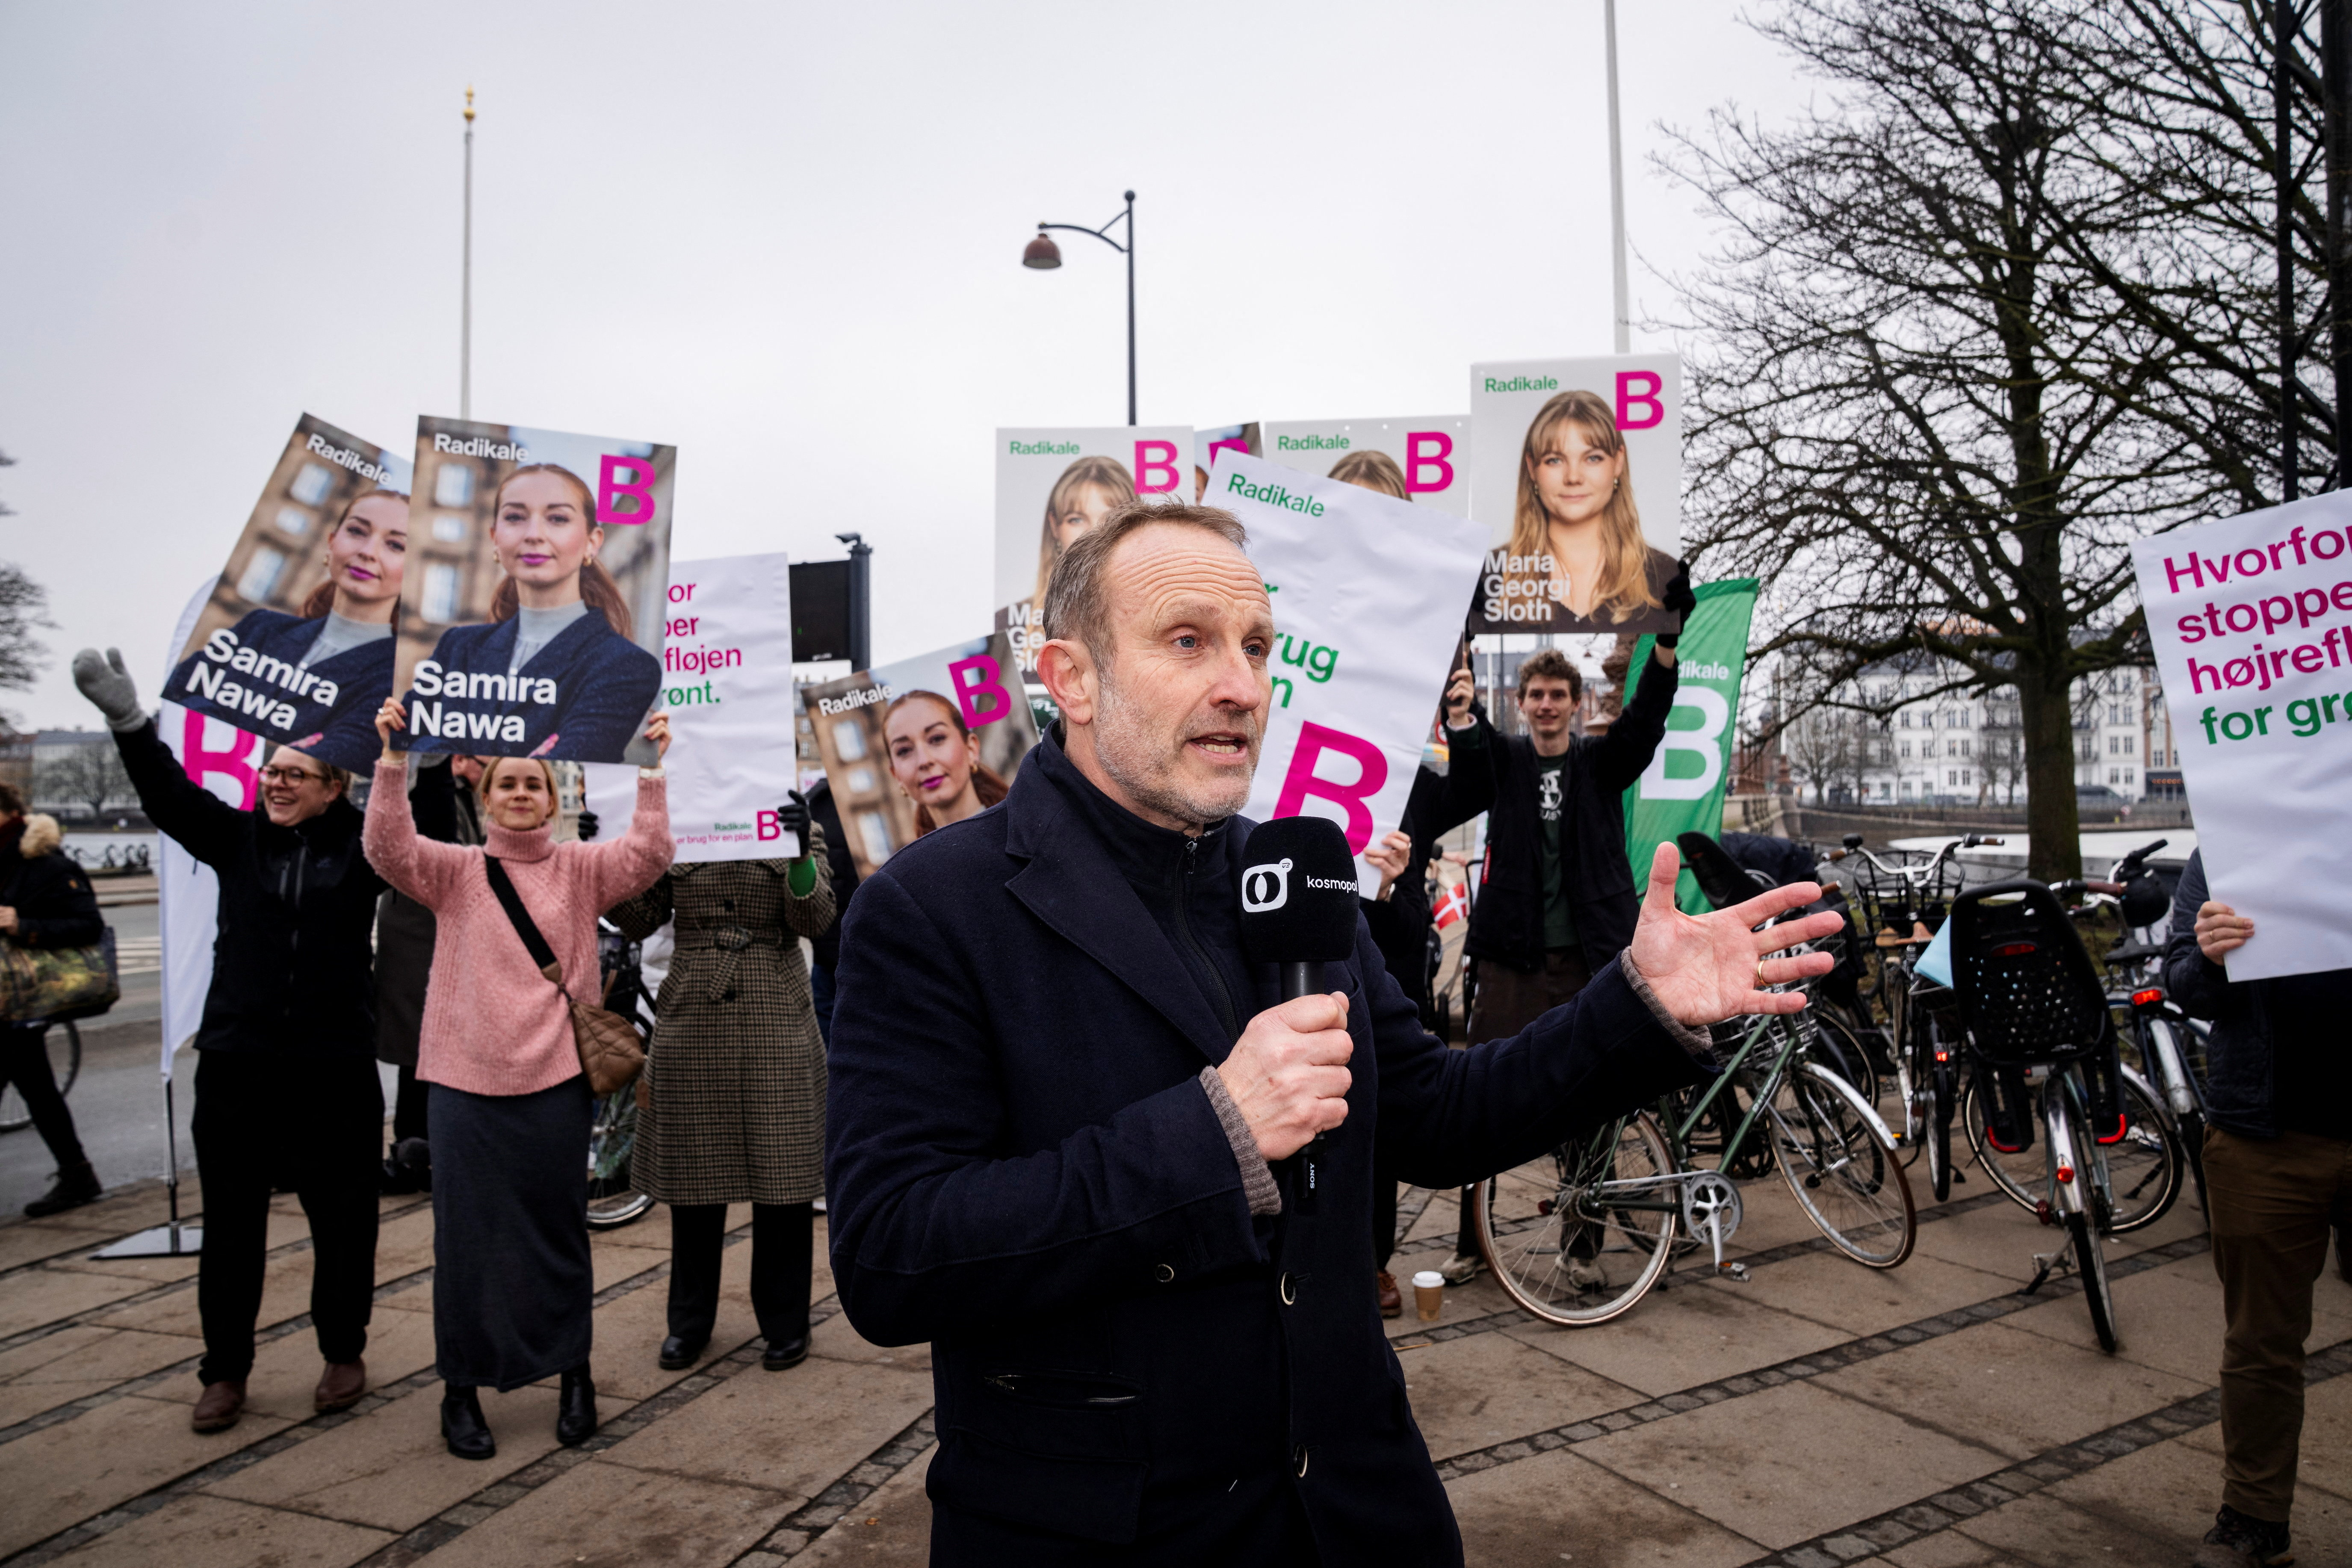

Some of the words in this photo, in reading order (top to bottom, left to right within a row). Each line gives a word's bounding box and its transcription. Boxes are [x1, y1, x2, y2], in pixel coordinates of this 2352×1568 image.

[1485, 375, 1558, 392] Radikale
[1616, 370, 1665, 431] B
[305, 434, 392, 486] Radikale
[434, 433, 529, 462] Radikale
[1010, 440, 1080, 455] Radikale
[1278, 434, 1350, 450] Radikale
[1405, 431, 1454, 494] B
[1134, 440, 1180, 495] B
[595, 454, 656, 526] B
[1227, 473, 1324, 517] Radikale
[1484, 550, 1555, 573] Maria
[1483, 574, 1571, 601] Georgi
[1484, 599, 1551, 621] Sloth
[2178, 582, 2352, 644] stoppe
[204, 628, 339, 707] Samira
[665, 644, 741, 675] fløjen
[186, 662, 297, 731] Nawa
[413, 660, 557, 705] Samira
[818, 683, 893, 717] Radikale
[948, 654, 1012, 730] B
[411, 700, 526, 742] Nawa
[2200, 706, 2272, 744] for
[181, 708, 260, 812] B
[1640, 685, 1729, 800] B
[1271, 720, 1389, 857] B
[687, 835, 707, 845] brug
[709, 834, 720, 843] for
[735, 833, 753, 842] plan
[715, 822, 752, 831] Radikale
[756, 810, 781, 842] B
[1307, 875, 1358, 893] kosmopol
